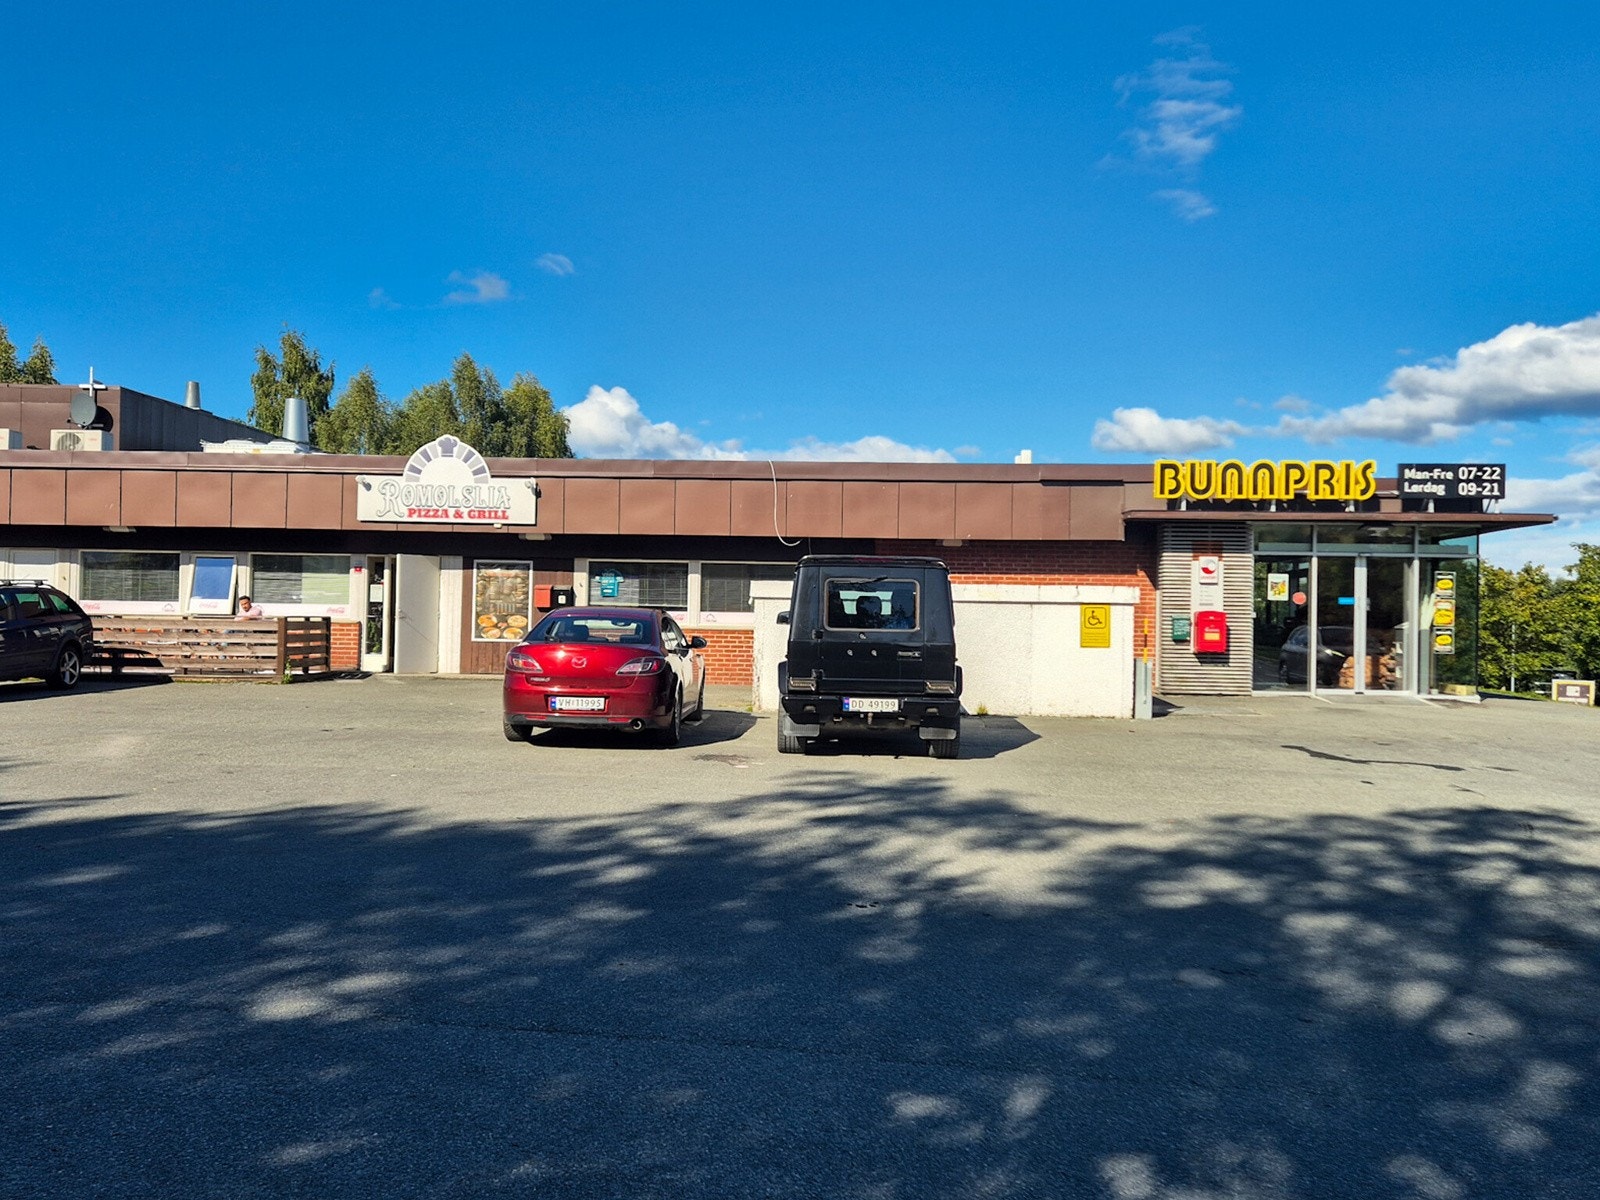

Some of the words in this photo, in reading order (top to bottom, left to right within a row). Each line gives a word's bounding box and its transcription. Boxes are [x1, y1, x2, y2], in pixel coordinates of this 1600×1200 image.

[1154, 459, 1377, 500] BUNNPRIS
[1403, 467, 1454, 480] Man-Fre
[1458, 466, 1501, 480] 07-22
[1457, 482, 1500, 496] 09-21
[377, 479, 511, 518] ROMOLSLIA
[407, 507, 449, 519] PIZZA
[453, 508, 464, 519] &
[467, 509, 509, 520] GRILL
